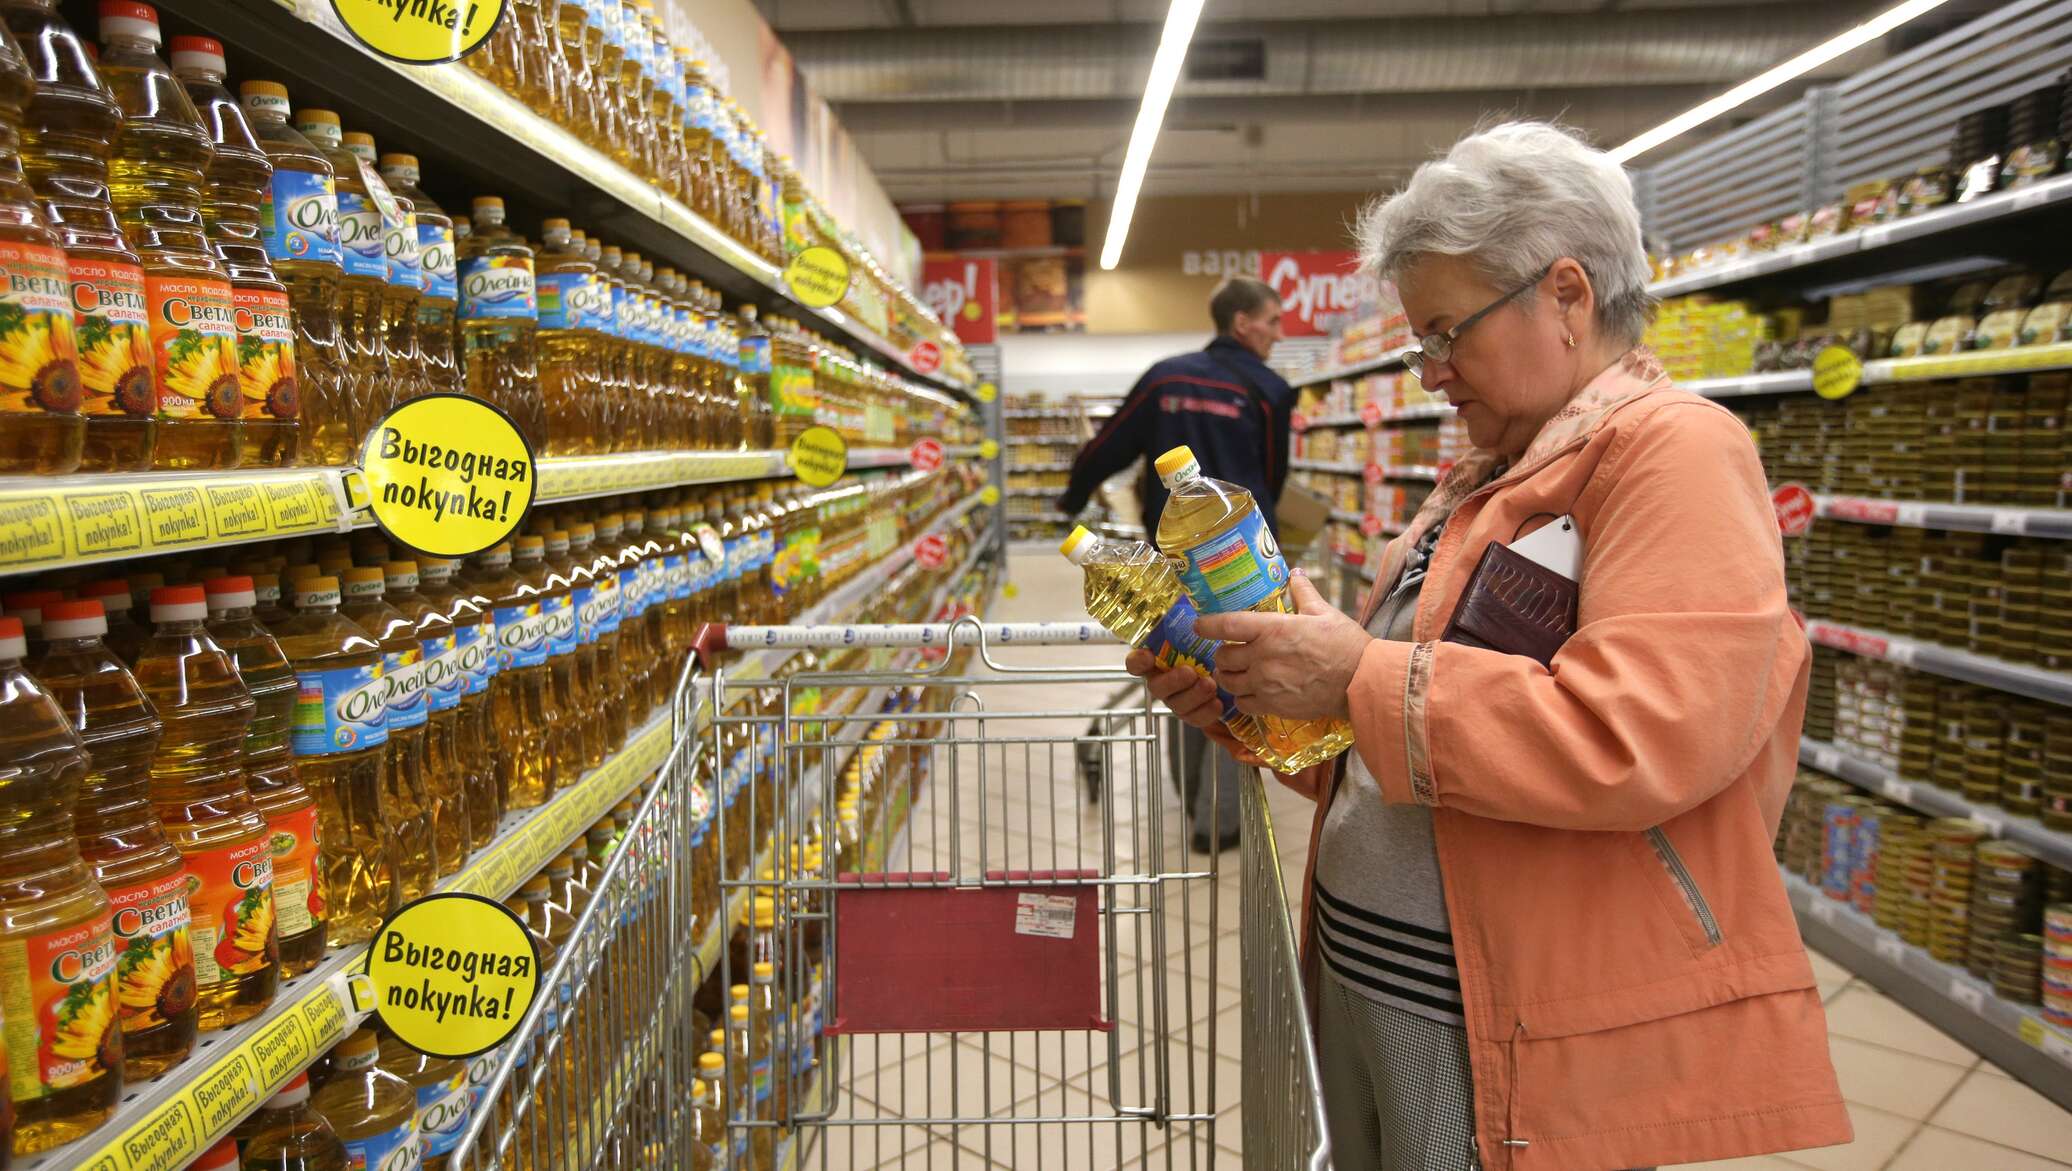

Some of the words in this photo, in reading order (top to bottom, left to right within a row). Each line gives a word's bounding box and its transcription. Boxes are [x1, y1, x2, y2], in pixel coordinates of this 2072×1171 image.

[366, 0, 478, 36] упка!
[160, 284, 198, 295] масло
[379, 426, 528, 483] Выгодная
[146, 489, 196, 513] Выгодная
[159, 507, 200, 538] покупка!
[223, 503, 260, 534] покупка!
[383, 476, 512, 524] покупка!
[85, 514, 133, 547] покупка!
[384, 930, 530, 984] Выгодная
[387, 978, 515, 1025] покупка!
[256, 1019, 296, 1063] Выгодная
[268, 1036, 303, 1081] покупка!
[198, 1060, 245, 1109] Выгодная
[210, 1078, 249, 1129] покупка!
[128, 1108, 183, 1164] Выгодная
